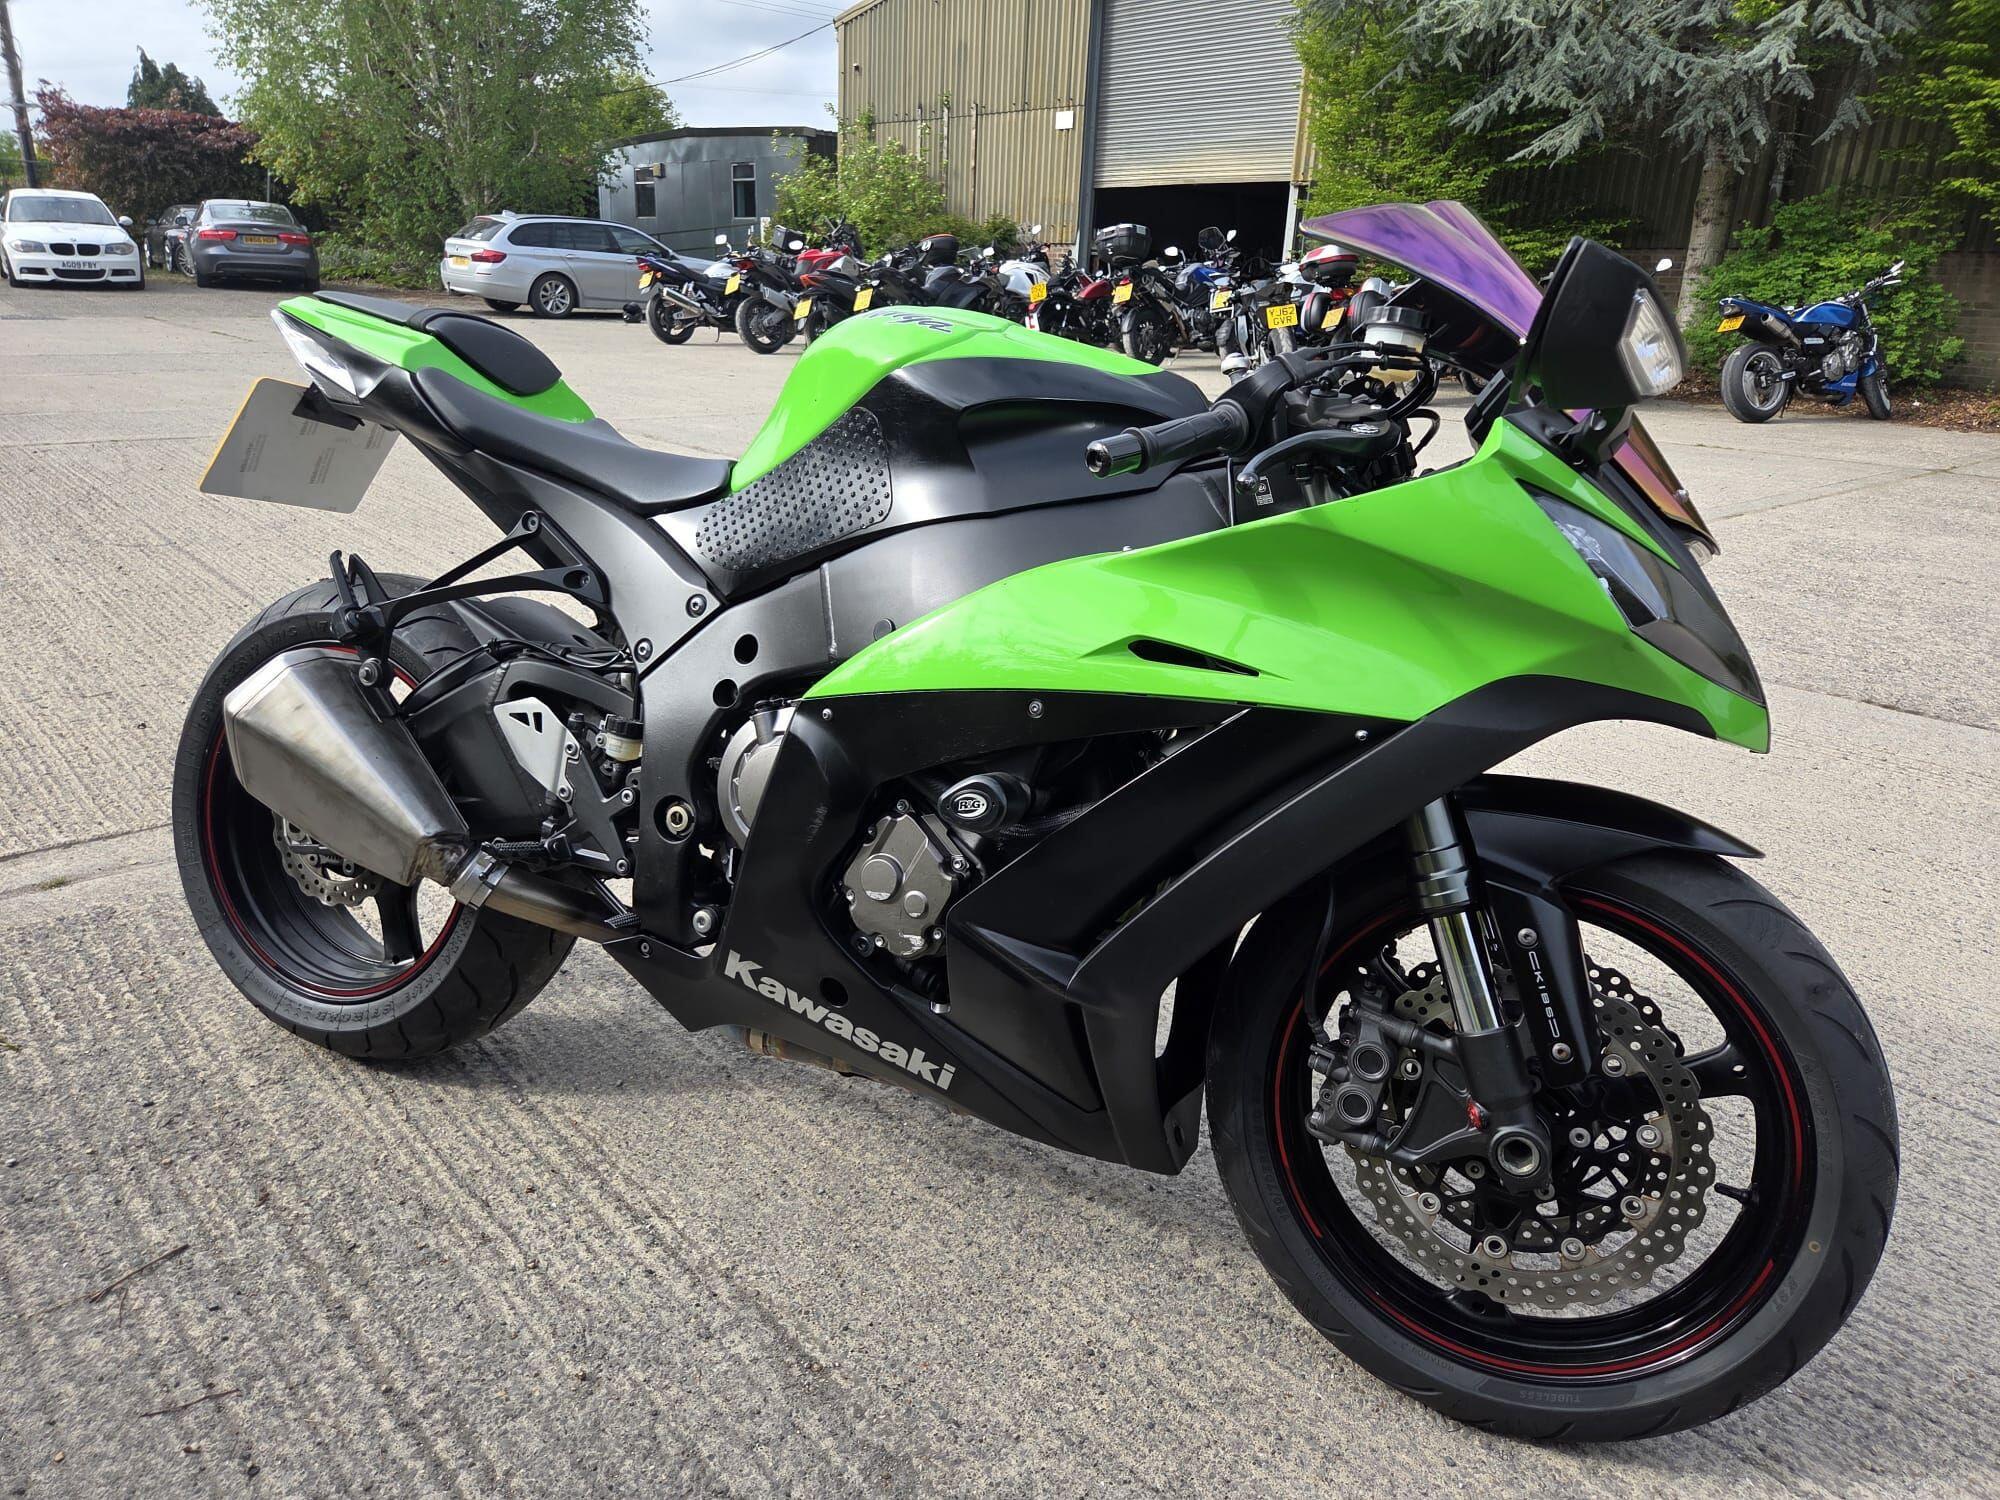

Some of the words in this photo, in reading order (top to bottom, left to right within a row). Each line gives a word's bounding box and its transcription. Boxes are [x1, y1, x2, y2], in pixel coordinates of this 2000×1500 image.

[1269, 306, 1295, 317] YJ62
[1273, 315, 1292, 326] GVR
[959, 800, 981, 810] R&G
[723, 950, 956, 1091] Kawasaki
